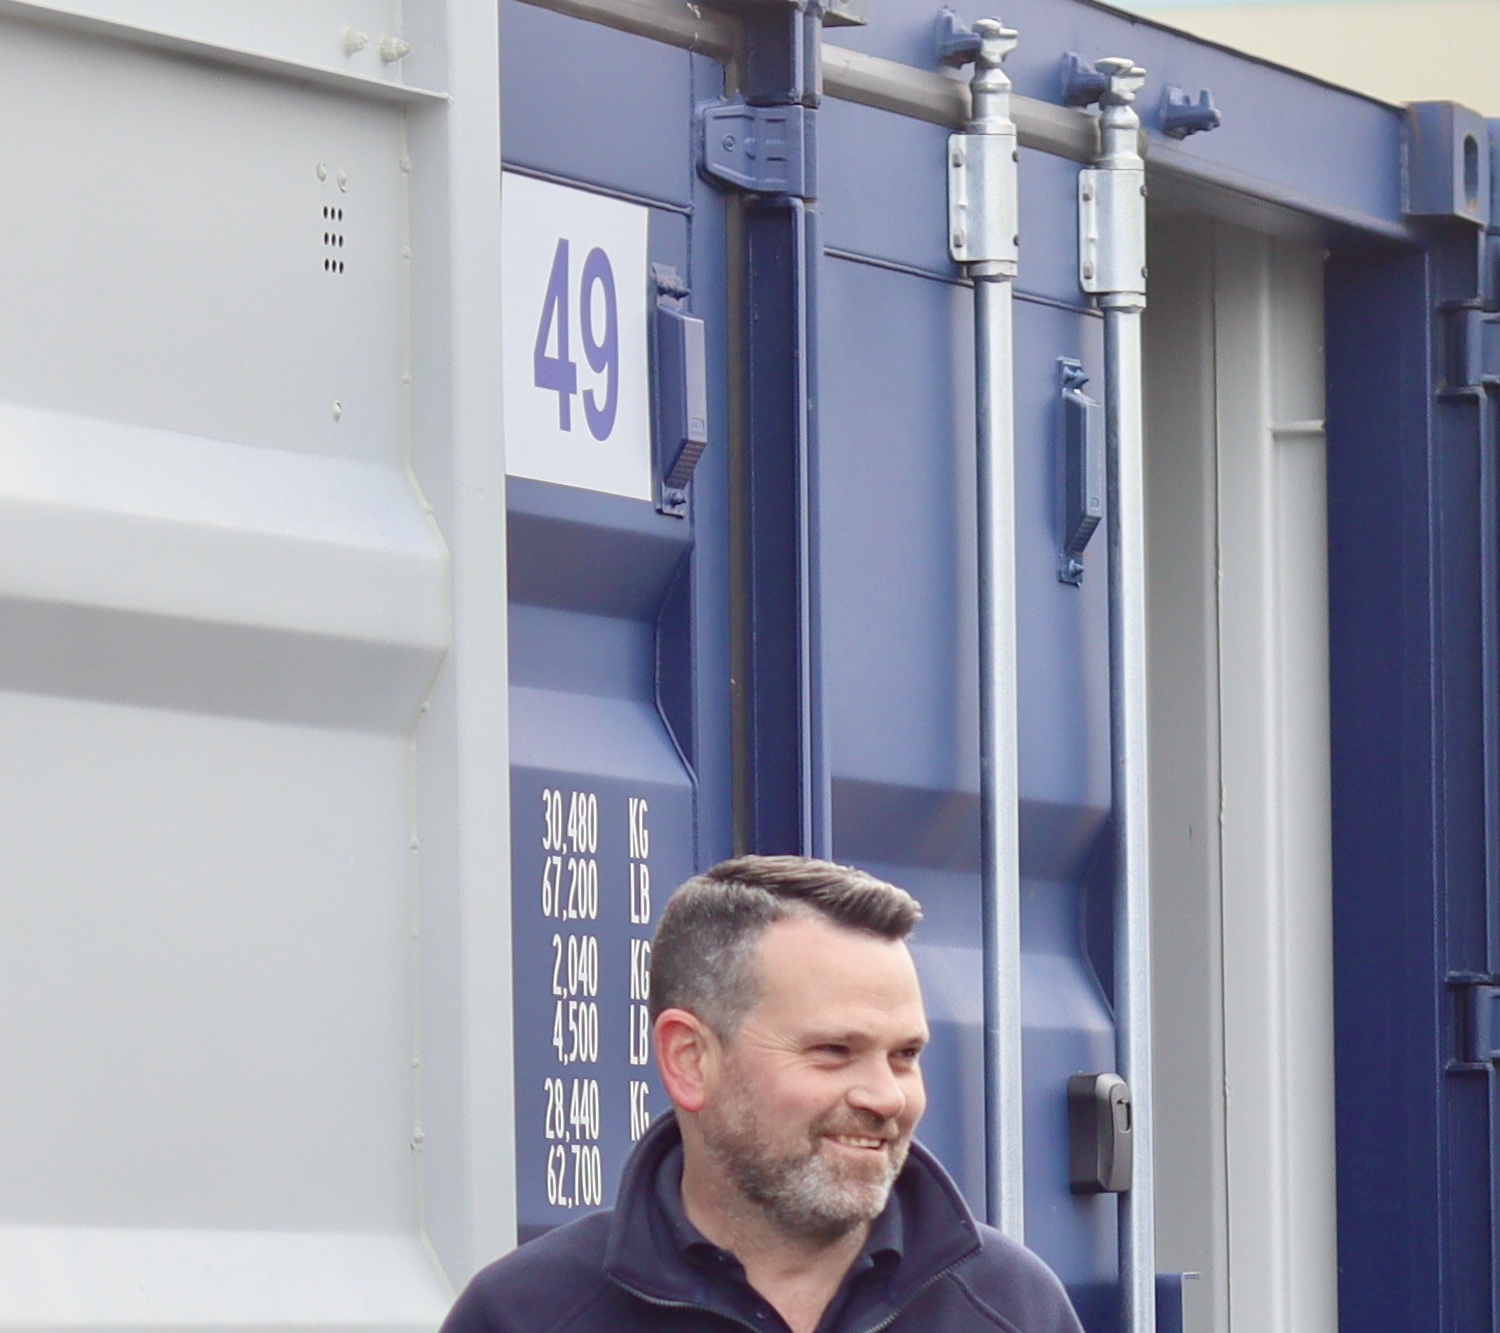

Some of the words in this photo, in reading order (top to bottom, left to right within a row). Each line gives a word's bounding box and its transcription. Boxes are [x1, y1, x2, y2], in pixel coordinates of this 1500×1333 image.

[534, 238, 619, 441] 49
[542, 788, 598, 855] 30,480
[628, 797, 650, 859] KG
[542, 855, 598, 922] 67,200
[629, 863, 651, 925] LB
[552, 933, 599, 999] 2,040
[630, 938, 652, 1000] KG
[552, 1000, 599, 1066] 4,500
[629, 1004, 650, 1066] LB
[544, 1077, 600, 1143] 28,440
[629, 1080, 650, 1142] KG
[547, 1144, 602, 1209] 62,700
